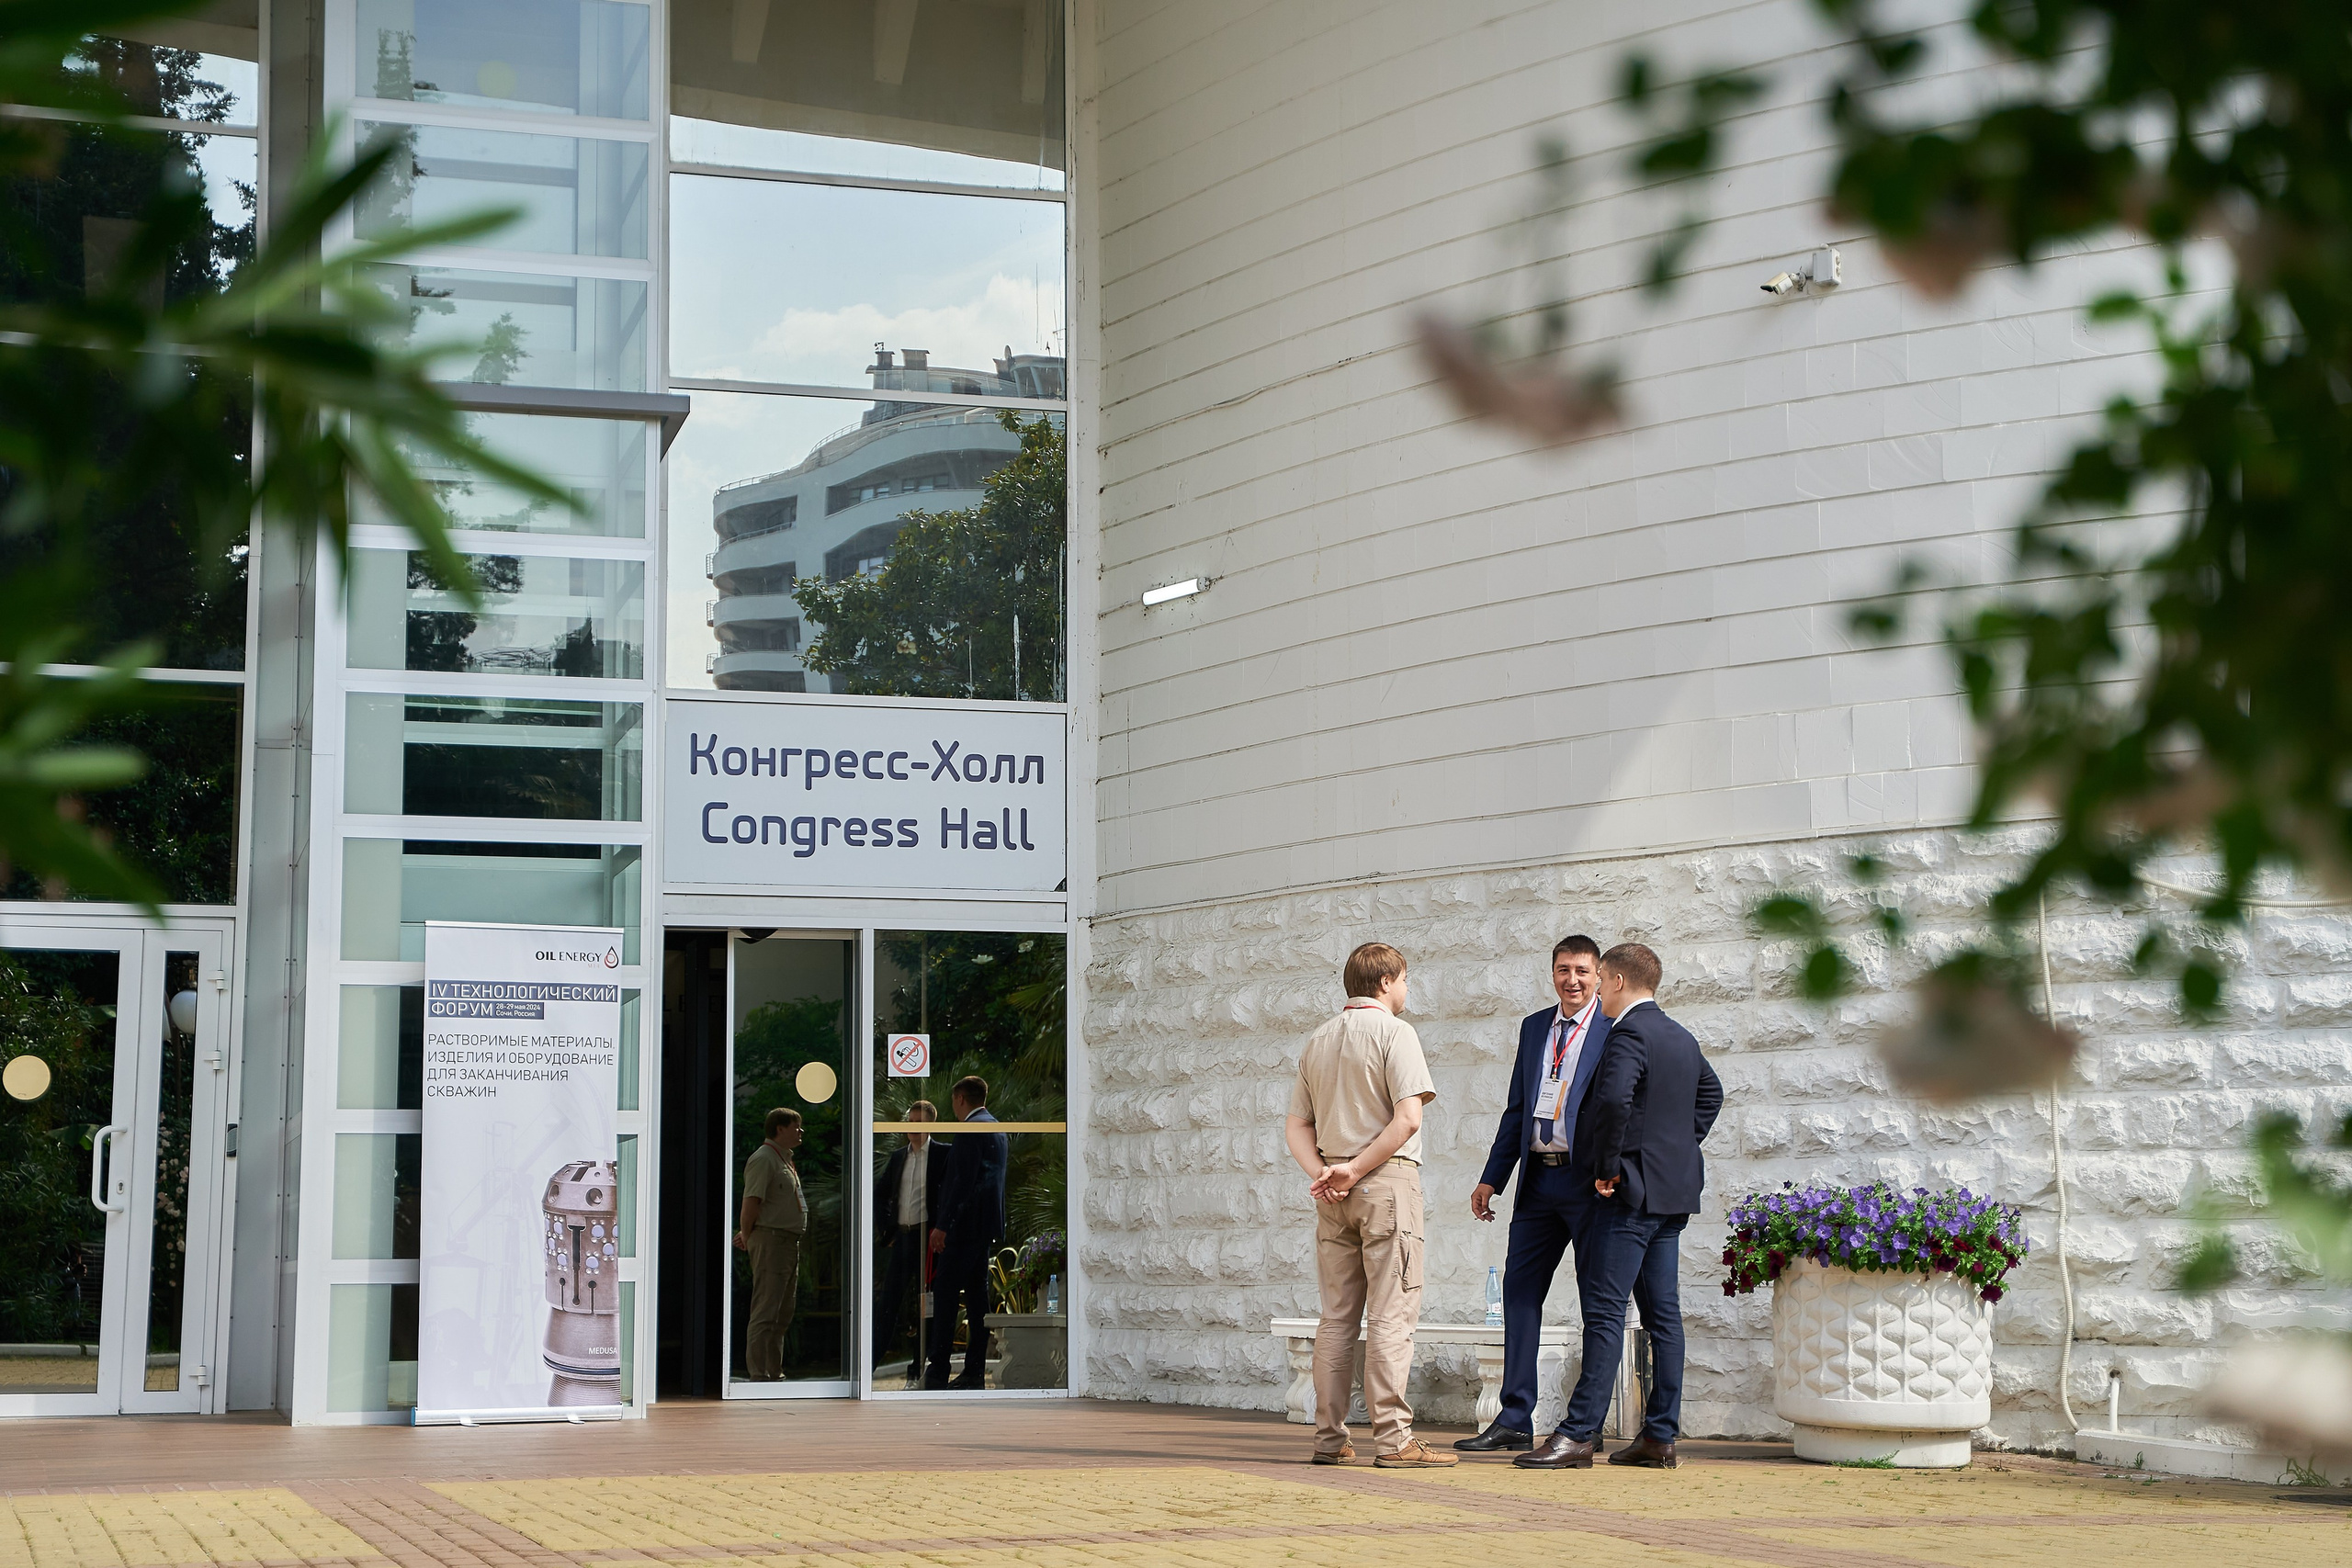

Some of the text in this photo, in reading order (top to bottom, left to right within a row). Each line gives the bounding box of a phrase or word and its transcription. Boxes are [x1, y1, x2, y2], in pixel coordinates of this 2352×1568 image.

[689, 731, 1045, 791] Конгресс-Холл
[701, 802, 1035, 858] Congress Hall
[536, 951, 602, 963] OIL ENERGY
[431, 983, 616, 1001] IV ТЕХНОЛОГИЧЕСКИЙ
[431, 1001, 492, 1017] ФОРУМ
[427, 1033, 528, 1047] РАСТВОРИМЫЕ
[427, 1051, 614, 1066] ИЗДЕЛИЯ И ОБОРУДОВАНИЕ
[427, 1068, 569, 1082] ДЛЯ ЗАКАНЧИВАНИЯ
[427, 1085, 497, 1097] СКВАЖИН
